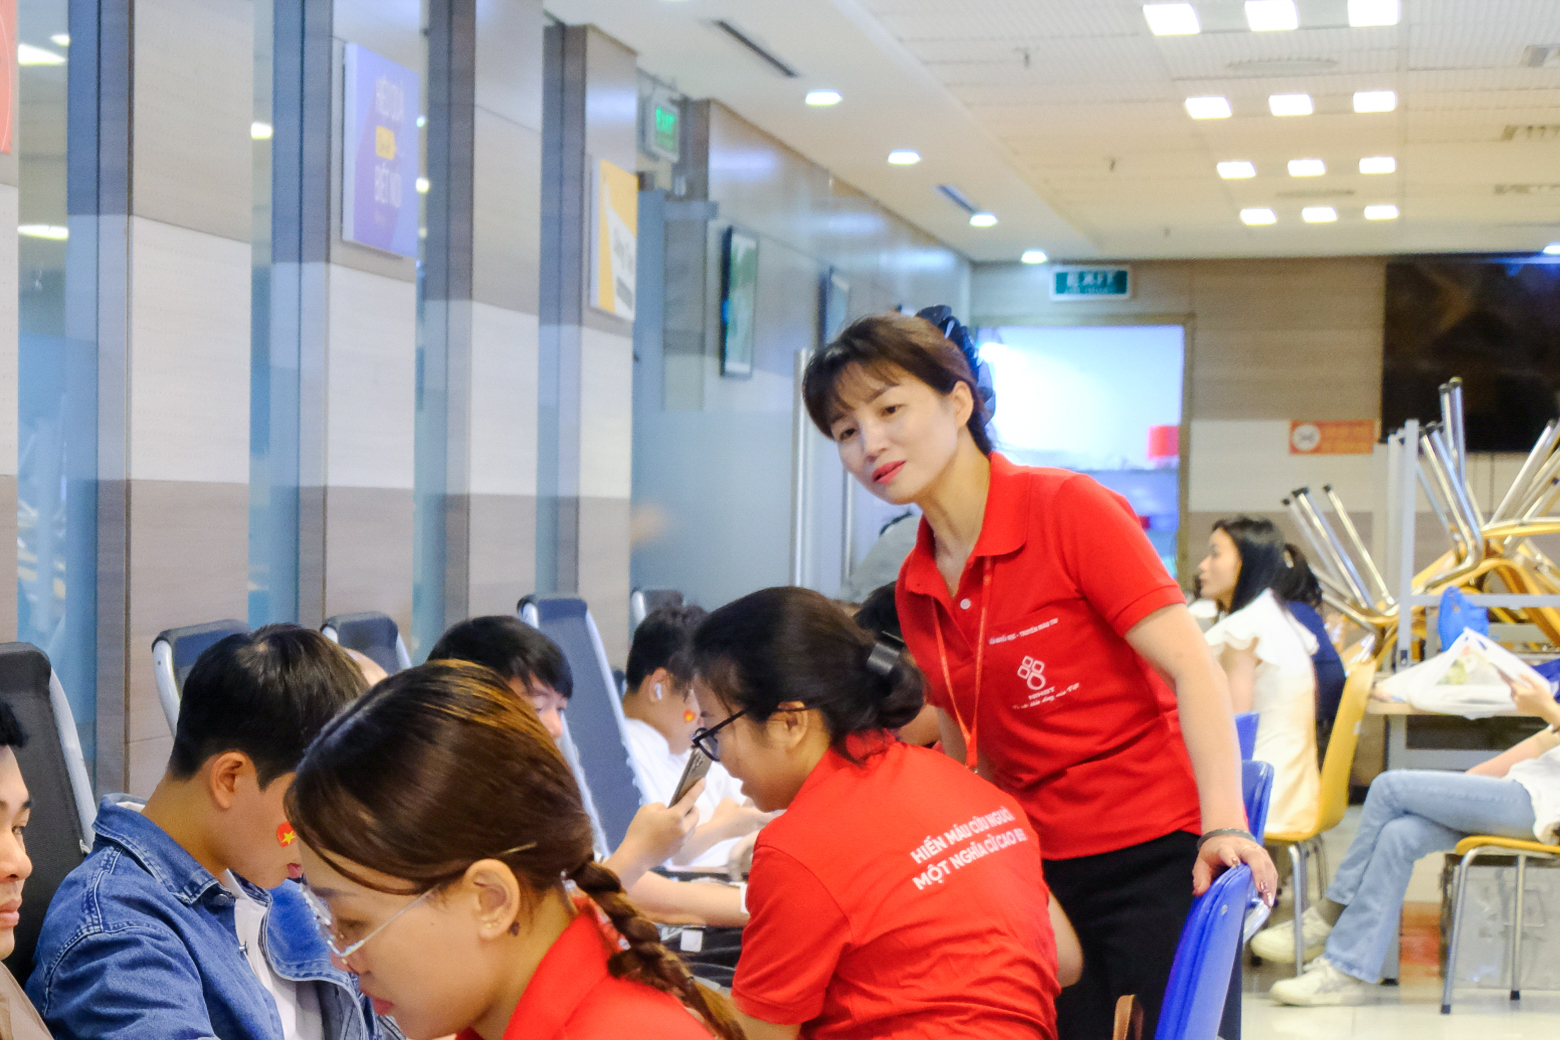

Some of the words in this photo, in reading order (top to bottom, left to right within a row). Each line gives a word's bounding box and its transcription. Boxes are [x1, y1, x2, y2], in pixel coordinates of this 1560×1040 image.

[910, 835, 948, 864] HIẾN
[944, 824, 972, 845] MÁU
[912, 860, 950, 890] MỘT
[949, 841, 988, 869] NGHĨA
[996, 831, 1016, 849] CAO
